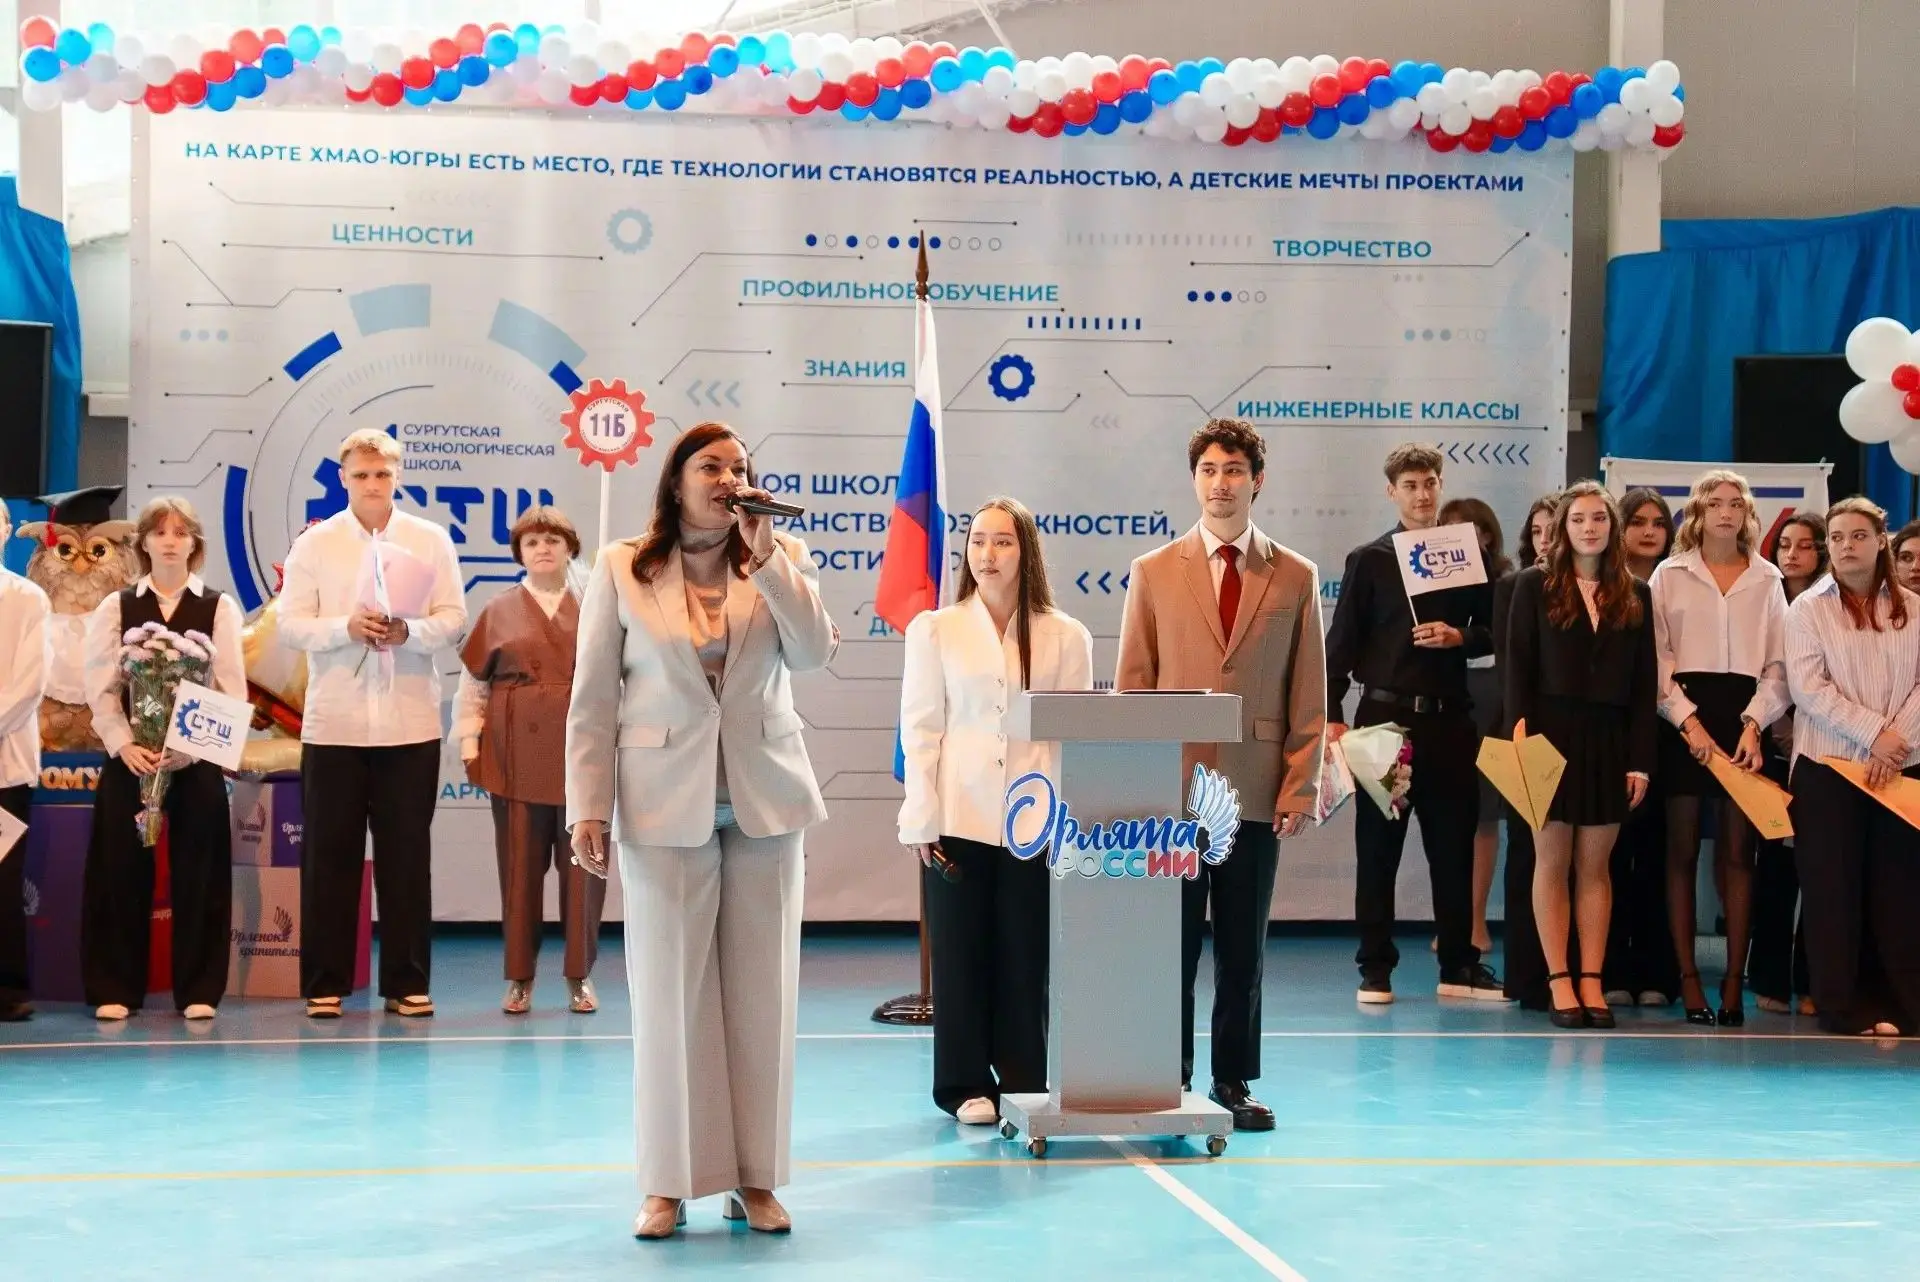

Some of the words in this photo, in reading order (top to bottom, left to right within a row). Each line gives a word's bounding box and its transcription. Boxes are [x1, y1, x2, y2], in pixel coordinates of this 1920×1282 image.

[185, 142, 219, 158] НА
[227, 143, 301, 161] КАРТЕ
[309, 147, 461, 168] ХМАО-ЮГРЫ
[468, 154, 526, 171] ЕСТЬ
[533, 155, 615, 176] МЕСТО,
[622, 158, 663, 177] ГДЕ
[671, 160, 821, 180] ТЕХНОЛОГИИ
[829, 165, 976, 184] СТАНОВЯТСЯ
[984, 168, 1162, 190] РЕАЛЬНОСТЬЮ,
[1168, 172, 1184, 188] А
[1189, 172, 1292, 190] ДЕТСКИЕ
[1300, 173, 1379, 190] МЕЧТЫ
[1386, 174, 1524, 192] ПРОЕКТАМИ
[333, 223, 474, 246] ЦЕННОСТИ
[1273, 239, 1432, 258] ТВОРЧЕСТВО
[743, 279, 918, 300] ПРОФИЛЬНОЕ
[927, 283, 1059, 301] ОБУЧЕНИЕ
[804, 359, 906, 378] ЗНАНИЯ
[1237, 400, 1413, 419] ИНЖЕНЕРНЫЕ
[1421, 402, 1520, 420] КЛАССЫ
[403, 424, 500, 438] СУРГУТСКАЯ
[590, 413, 626, 437] 11Б
[403, 441, 555, 456] ТЕХНОЛОГИЧЕСКАЯ
[403, 459, 462, 472] ШКОЛА
[756, 474, 801, 494] ОЯ
[812, 474, 899, 495] ШКОЛ
[1425, 549, 1466, 567] СТШ
[191, 713, 232, 739] СТШ
[1006, 772, 1200, 867] Орлята
[1055, 850, 1197, 878] РОССИИ
